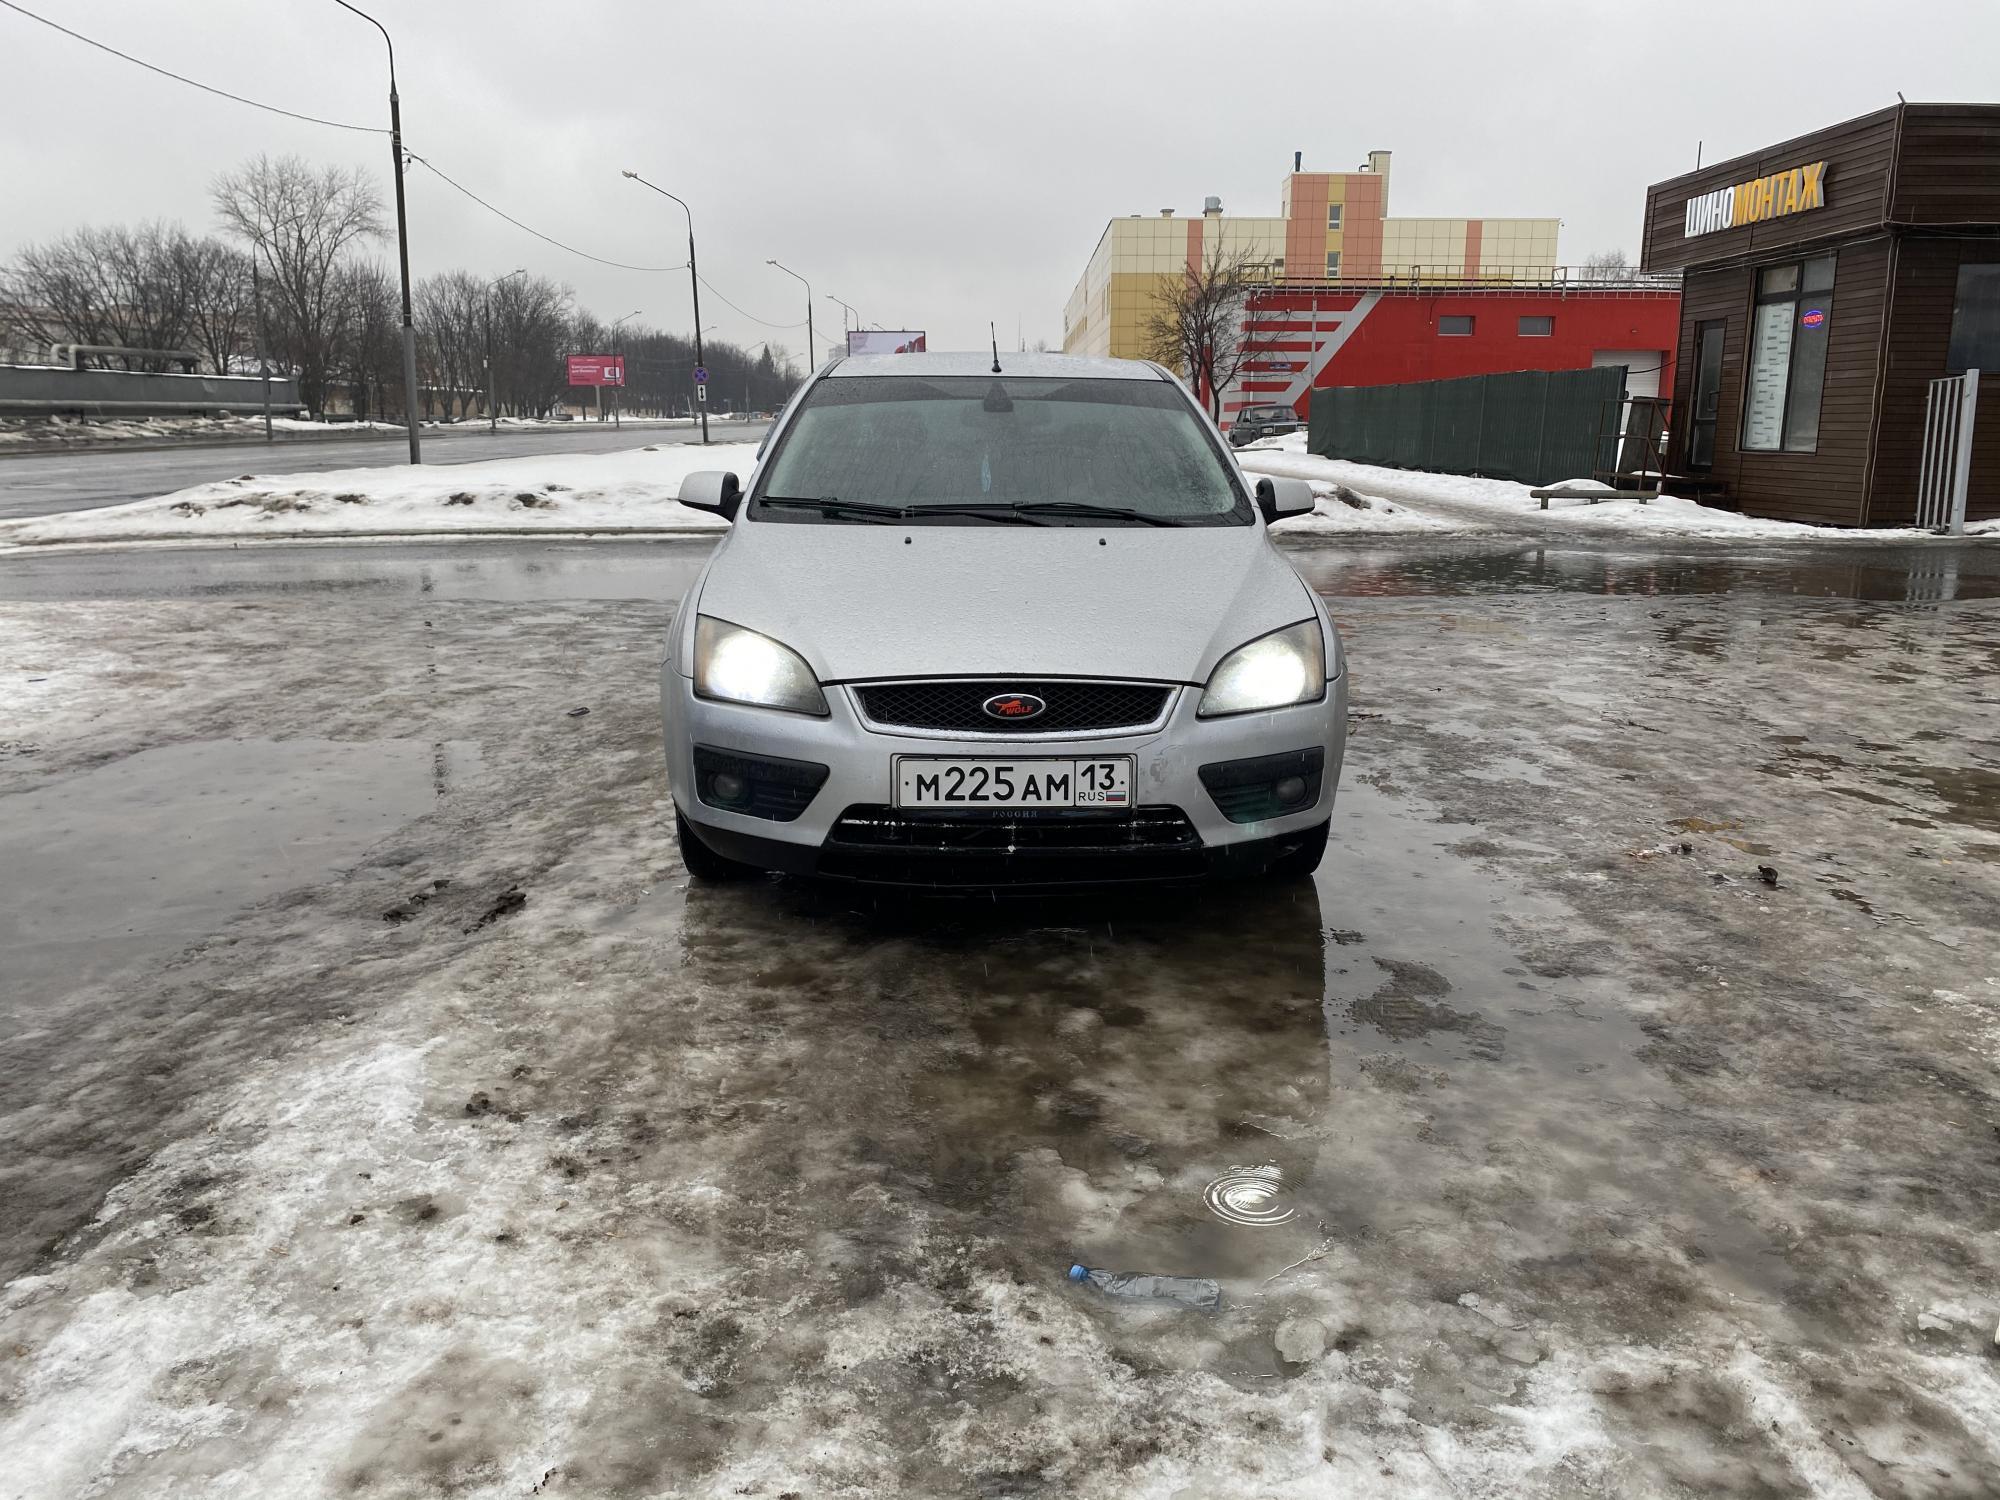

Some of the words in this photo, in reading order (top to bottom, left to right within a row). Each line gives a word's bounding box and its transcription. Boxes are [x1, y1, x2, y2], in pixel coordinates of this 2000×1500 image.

[1684, 161, 1828, 239] ШИНОМОНТАЖ
[1006, 704, 1033, 715] WOLF
[1080, 763, 1115, 791] 13
[1078, 791, 1105, 802] RUS
